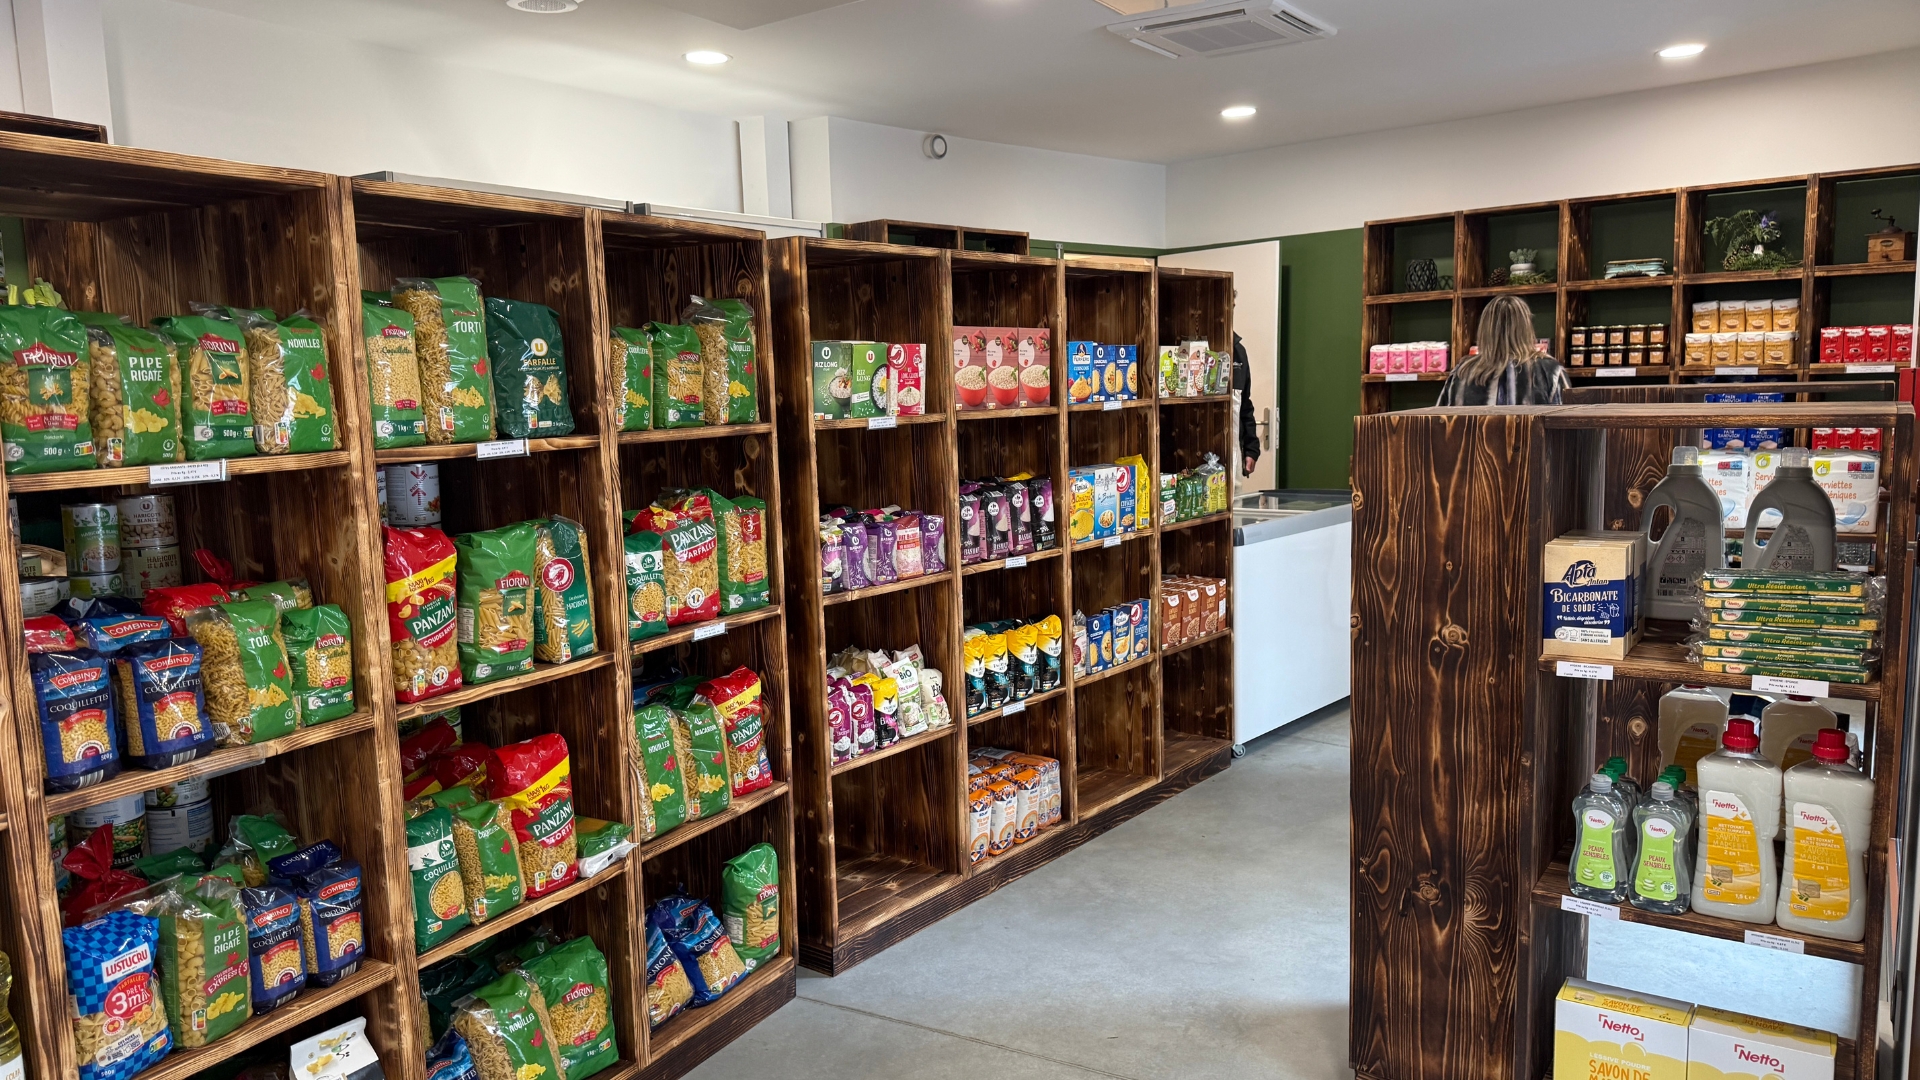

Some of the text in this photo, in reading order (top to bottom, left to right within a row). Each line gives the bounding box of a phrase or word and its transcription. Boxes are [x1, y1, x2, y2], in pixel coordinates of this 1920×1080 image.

[454, 321, 482, 333] TORTI
[201, 339, 236, 352] FIORINI
[287, 338, 320, 348] NOUILLES
[535, 343, 544, 352] U
[22, 350, 73, 368] FIORINI
[824, 349, 830, 357] U
[128, 357, 163, 368] PIPE
[130, 370, 163, 382] RIGATE
[1755, 472, 1775, 481] Servi
[670, 522, 715, 548] PANZANI
[147, 554, 177, 563] HARICOTS
[501, 577, 529, 590] FIORINI
[1562, 604, 1596, 612] DE SOUDE
[412, 602, 454, 634] PANZANI
[109, 622, 159, 636] COMBINO
[317, 636, 344, 649] FIORINI
[423, 630, 444, 646] COUDES
[150, 656, 190, 668] COMBINO
[57, 671, 97, 685] COMBINO
[899, 669, 912, 680] BIO
[50, 693, 109, 713] COQUILLETTES
[694, 725, 717, 736] MACARONI
[732, 718, 761, 743] PANZANI
[648, 740, 670, 754] NOUILLES
[744, 735, 761, 750] TORTI
[1715, 801, 1735, 809] Netto
[533, 801, 572, 836] PANZANI
[1590, 817, 1604, 825] Netto
[1803, 814, 1825, 822] Netto
[1716, 833, 1740, 841] SAVON
[114, 852, 141, 864] aucy
[1583, 850, 1609, 860] SENSIBLES
[1802, 846, 1828, 856] SAVON
[1644, 861, 1671, 870] SENSIBLES
[321, 880, 356, 897] COMBINO
[258, 908, 289, 924] COMBINO
[214, 926, 240, 945] PIPE
[214, 938, 241, 954] RIGATE
[105, 949, 148, 977] LUSTUCRU
[118, 975, 145, 991] FARFALLES
[208, 969, 238, 994] EXPRESS
[566, 984, 593, 1002] FIORINI
[111, 992, 128, 1015] 3
[508, 1012, 535, 1034] NOUILLES
[1602, 1019, 1639, 1035] Netto
[1589, 1052, 1651, 1070] LESSIVE POUDRE
[1738, 1049, 1780, 1067] Netto
[1589, 1059, 1650, 1080] SAVON DE
